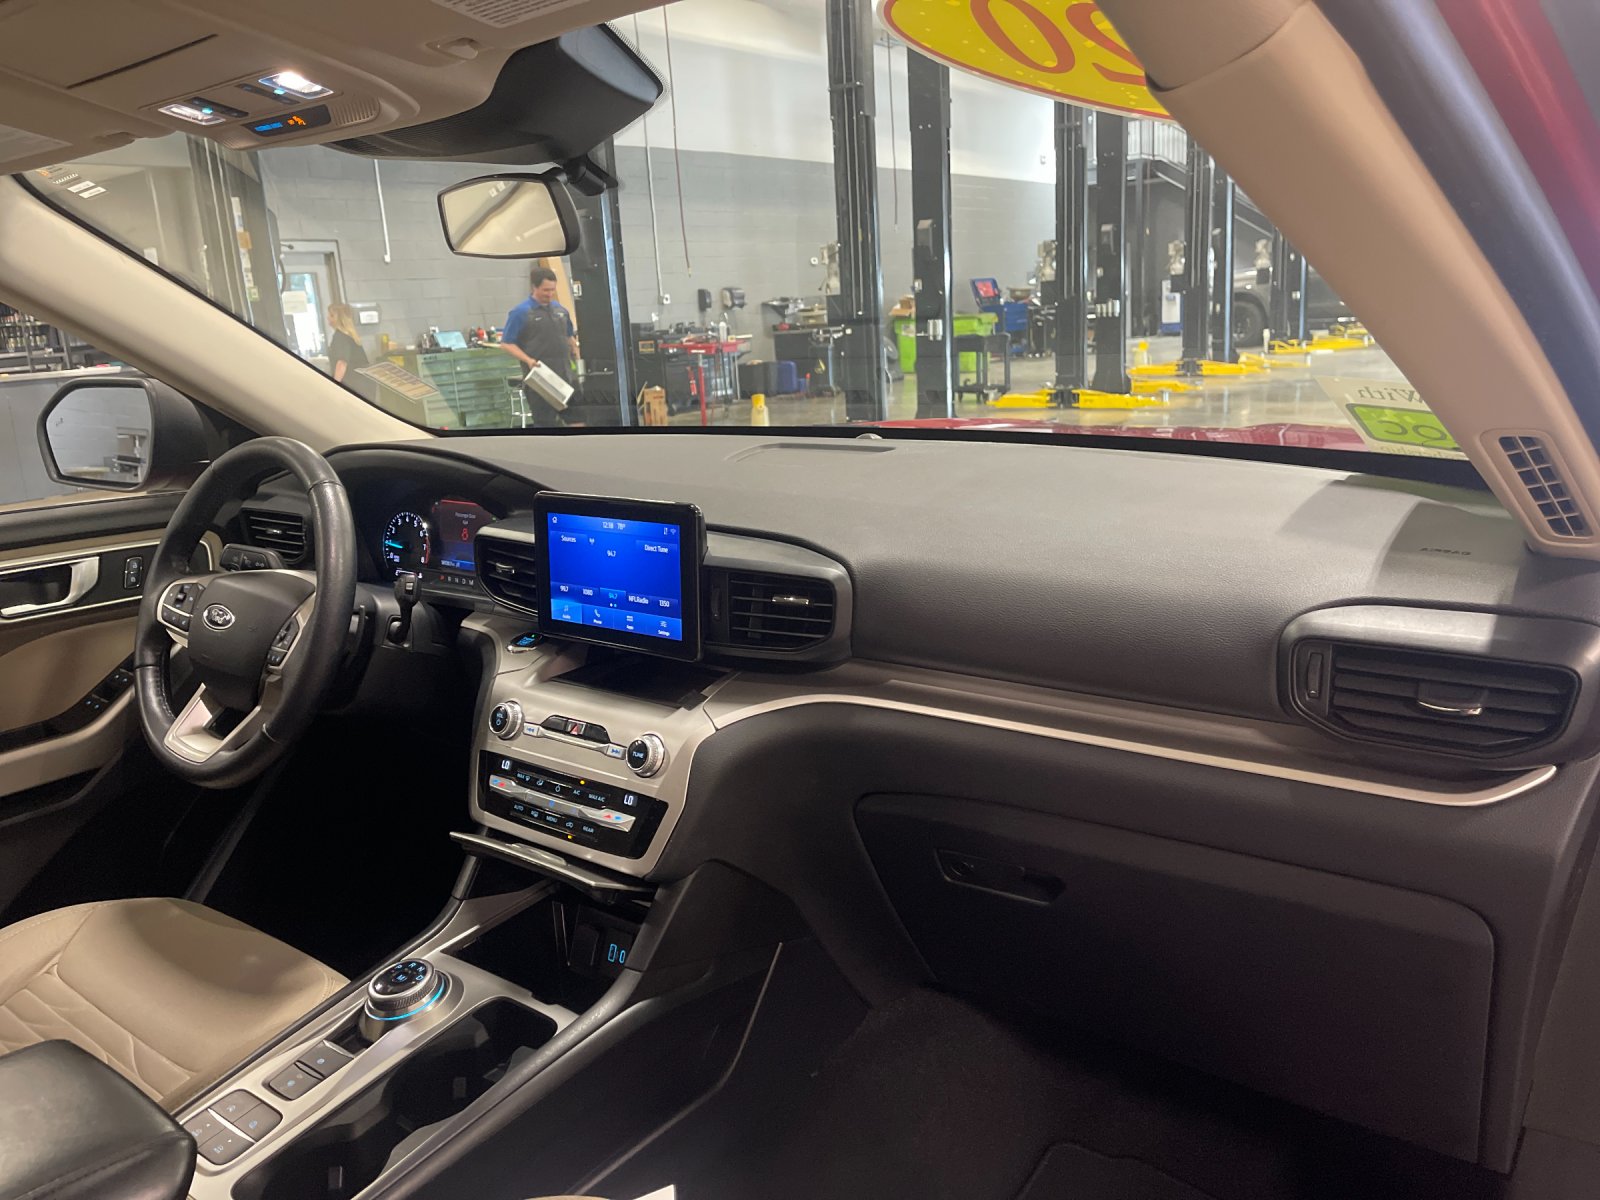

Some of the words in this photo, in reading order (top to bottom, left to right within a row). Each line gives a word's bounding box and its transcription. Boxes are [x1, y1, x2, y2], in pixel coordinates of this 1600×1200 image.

[560, 534, 576, 543] Sources
[644, 544, 657, 552] Direct
[657, 545, 668, 554] Tune
[502, 760, 510, 770] LO
[624, 795, 634, 806] LO
[514, 804, 524, 812] AUTO
[546, 815, 558, 823] MENU
[582, 824, 594, 833] REAR
